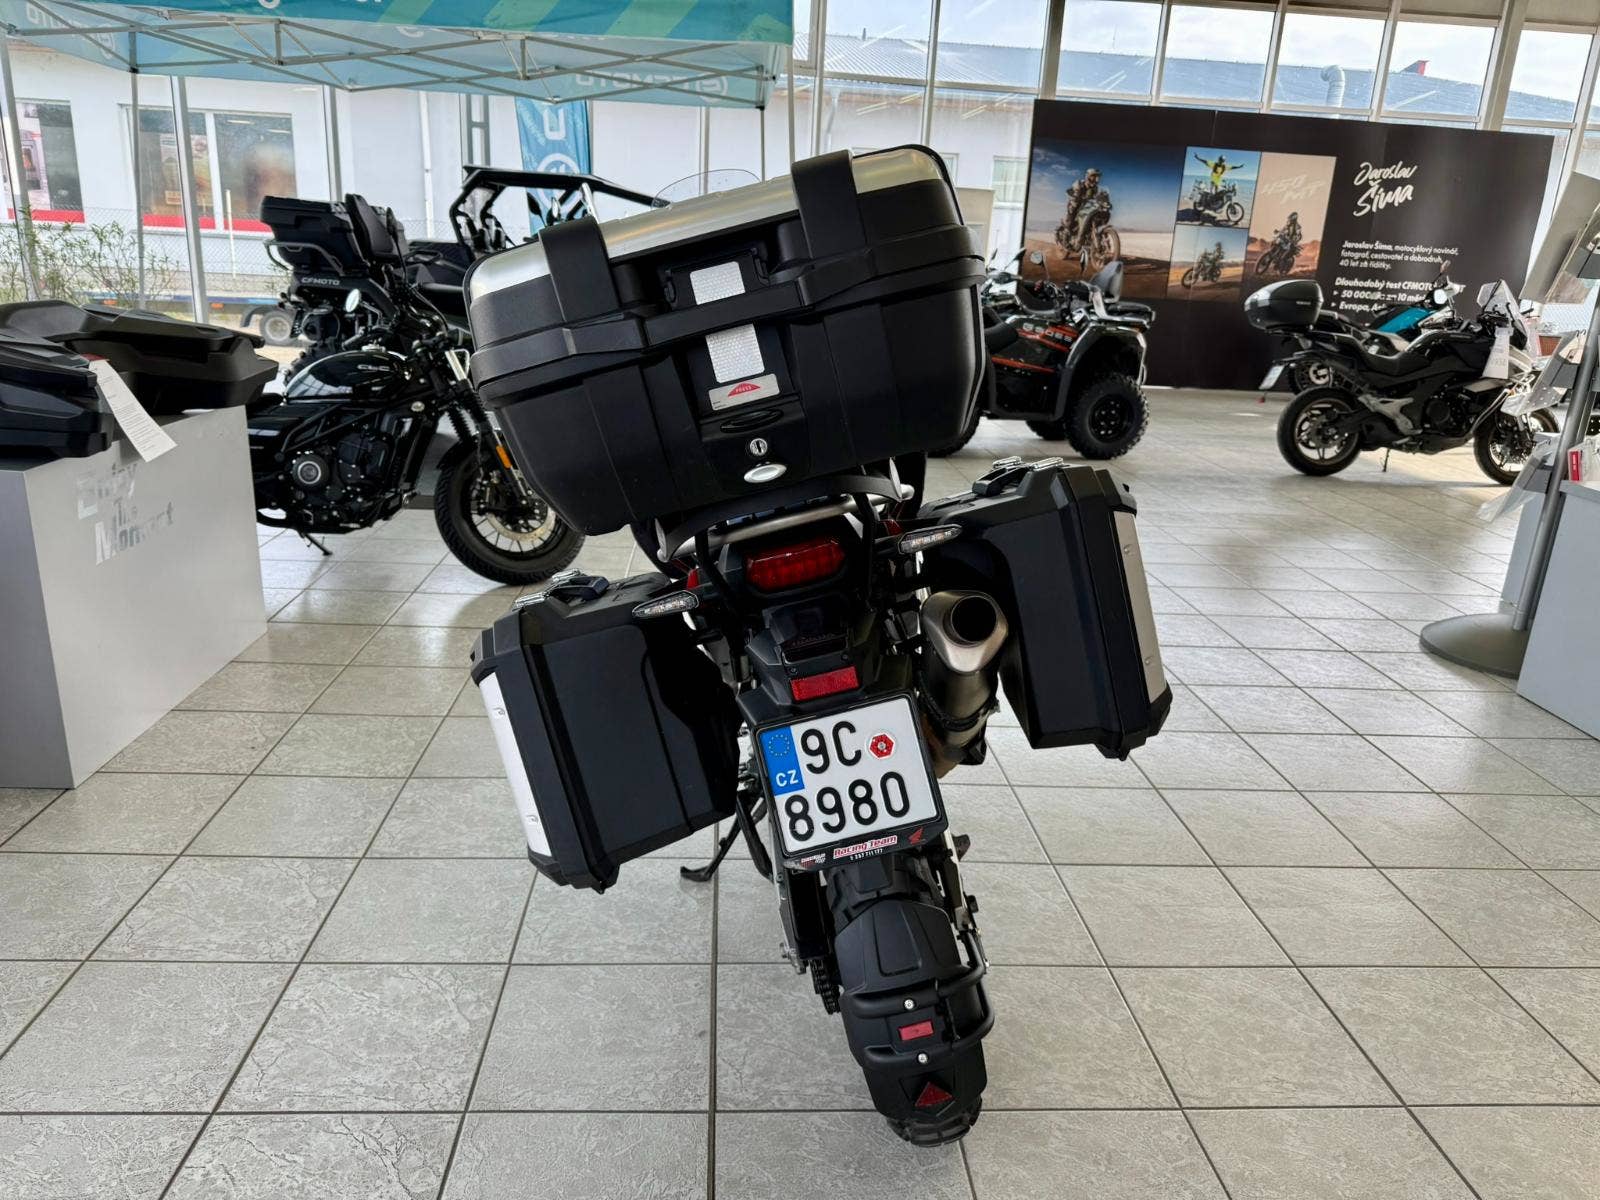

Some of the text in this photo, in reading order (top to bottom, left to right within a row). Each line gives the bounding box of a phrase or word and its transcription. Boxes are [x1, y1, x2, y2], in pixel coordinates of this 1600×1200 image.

[1353, 161, 1418, 186] Jaroslav
[1353, 179, 1414, 217] Šima
[1342, 240, 1374, 250] Jaroslav
[1339, 259, 1349, 267] 40
[1350, 259, 1359, 267] let
[301, 276, 341, 286] CFMOTO
[1335, 277, 1386, 291] Dlouhodobý
[1386, 281, 1401, 289] test
[1341, 289, 1353, 299] 50
[801, 721, 862, 774] 9C
[775, 769, 800, 787] CZ
[784, 771, 910, 842] 8980
[833, 841, 868, 860] Racing
[869, 835, 898, 851] Team
